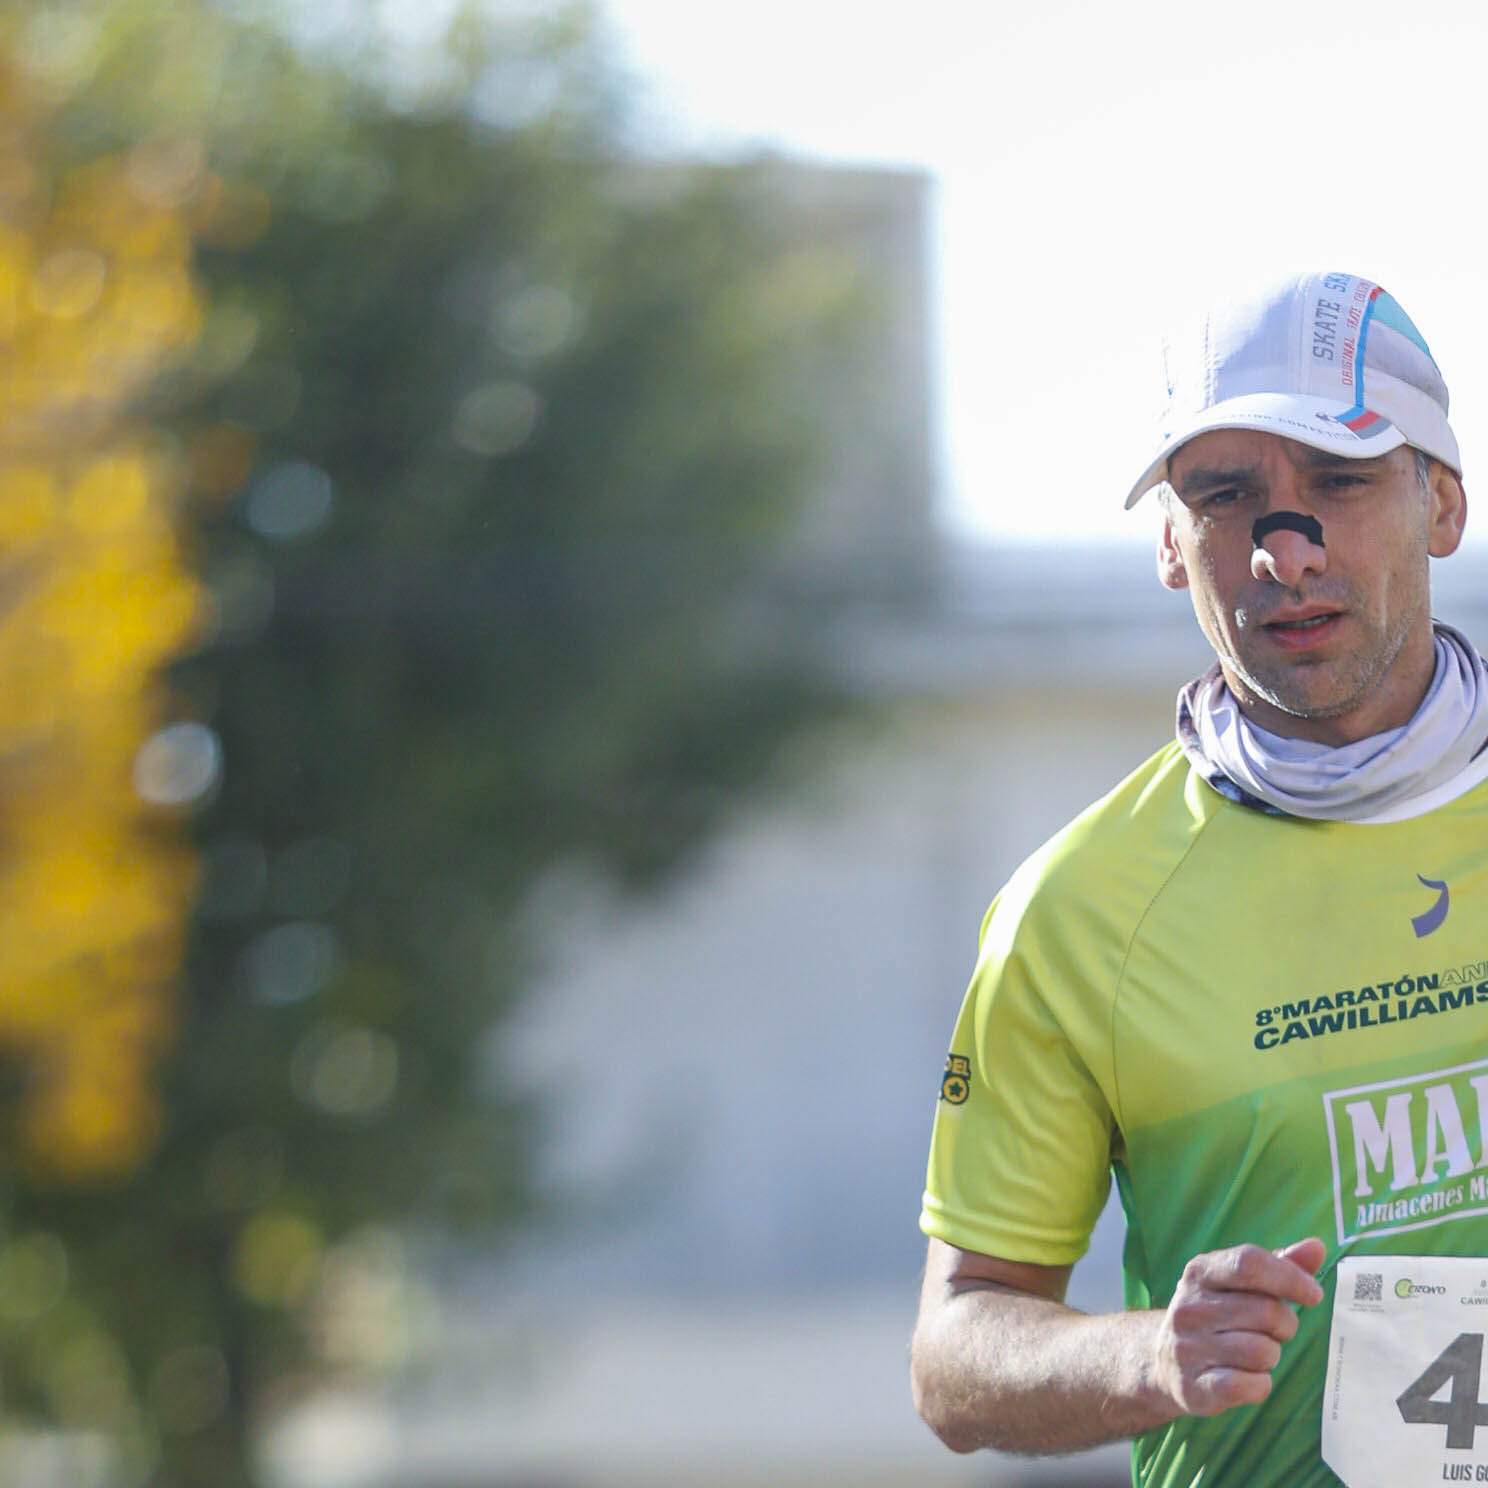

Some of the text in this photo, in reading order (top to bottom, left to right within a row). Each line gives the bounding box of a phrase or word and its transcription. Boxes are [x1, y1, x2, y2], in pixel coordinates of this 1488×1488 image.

[1312, 297, 1342, 361] SKATE
[1356, 1184, 1464, 1228] Almacenes
[1443, 1463, 1473, 1482] LUIS
